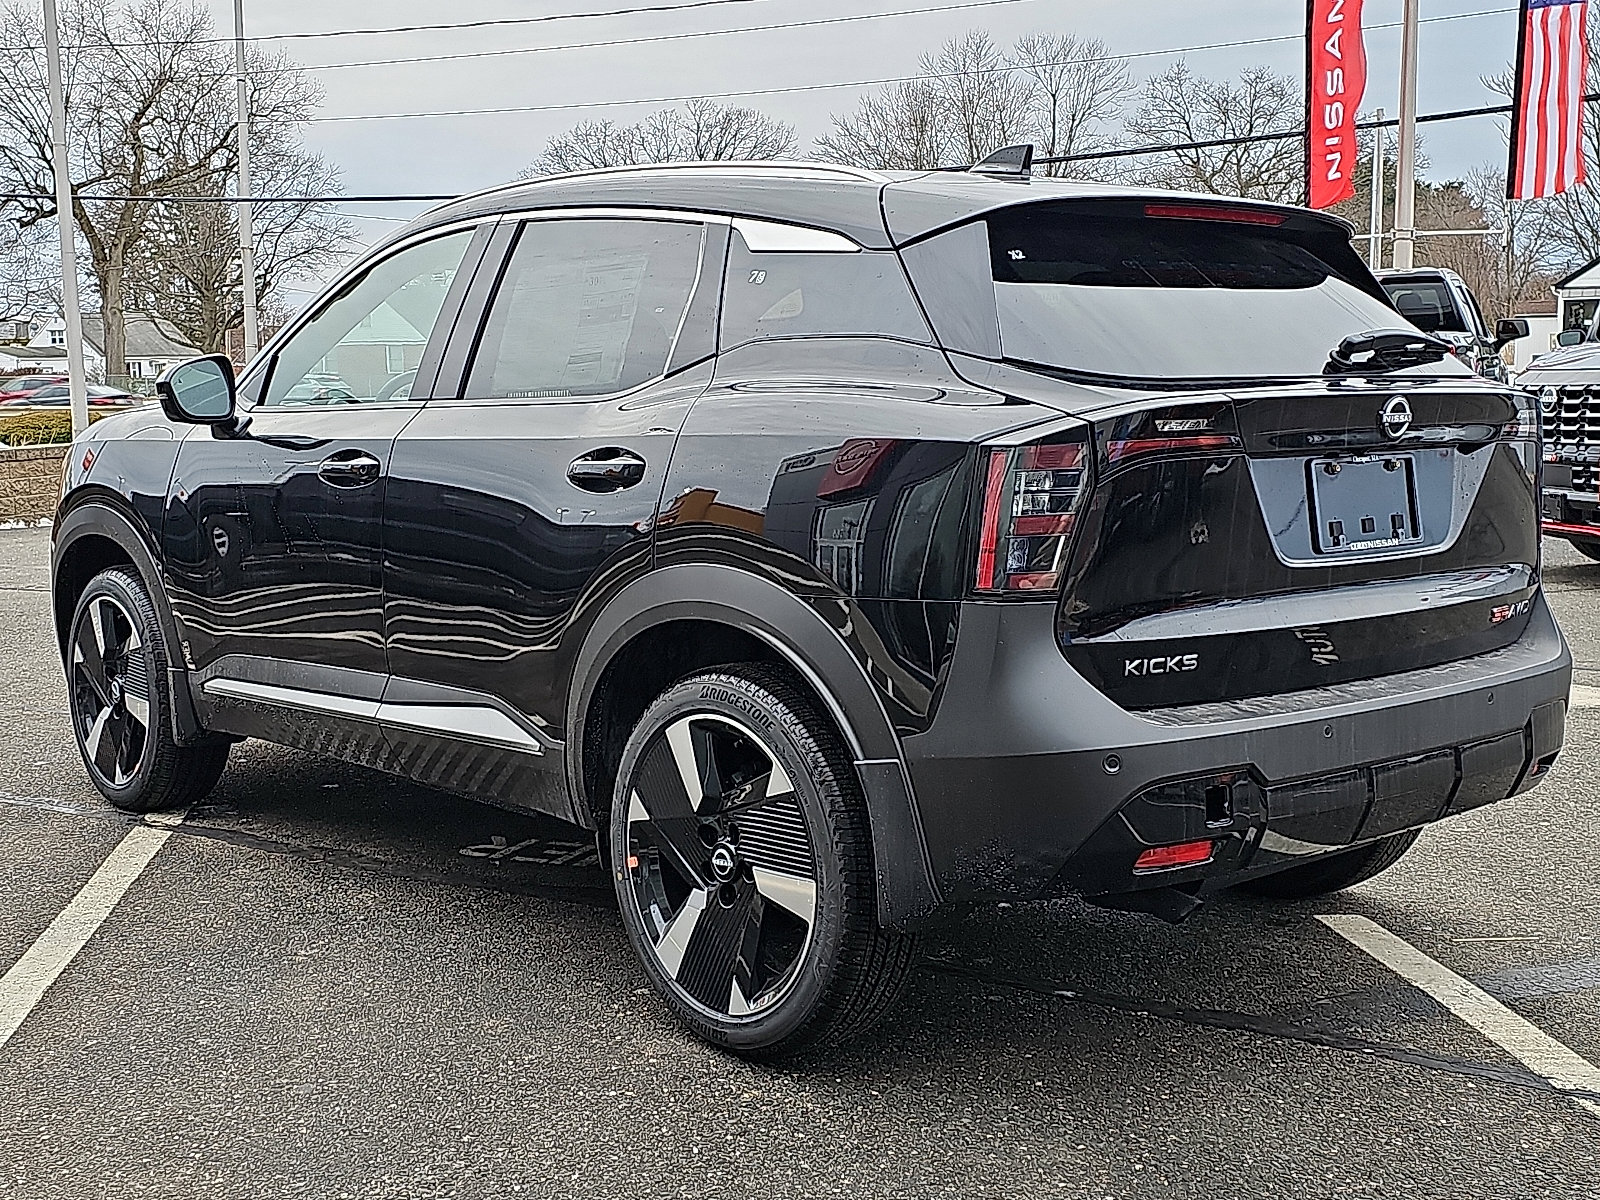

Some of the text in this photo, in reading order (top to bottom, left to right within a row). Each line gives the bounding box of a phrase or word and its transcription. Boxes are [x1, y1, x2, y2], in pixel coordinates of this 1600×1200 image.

[1324, 0, 1345, 182] NISSAN
[1123, 653, 1199, 677] KICKS
[698, 685, 777, 733] BRIDGESTONE
